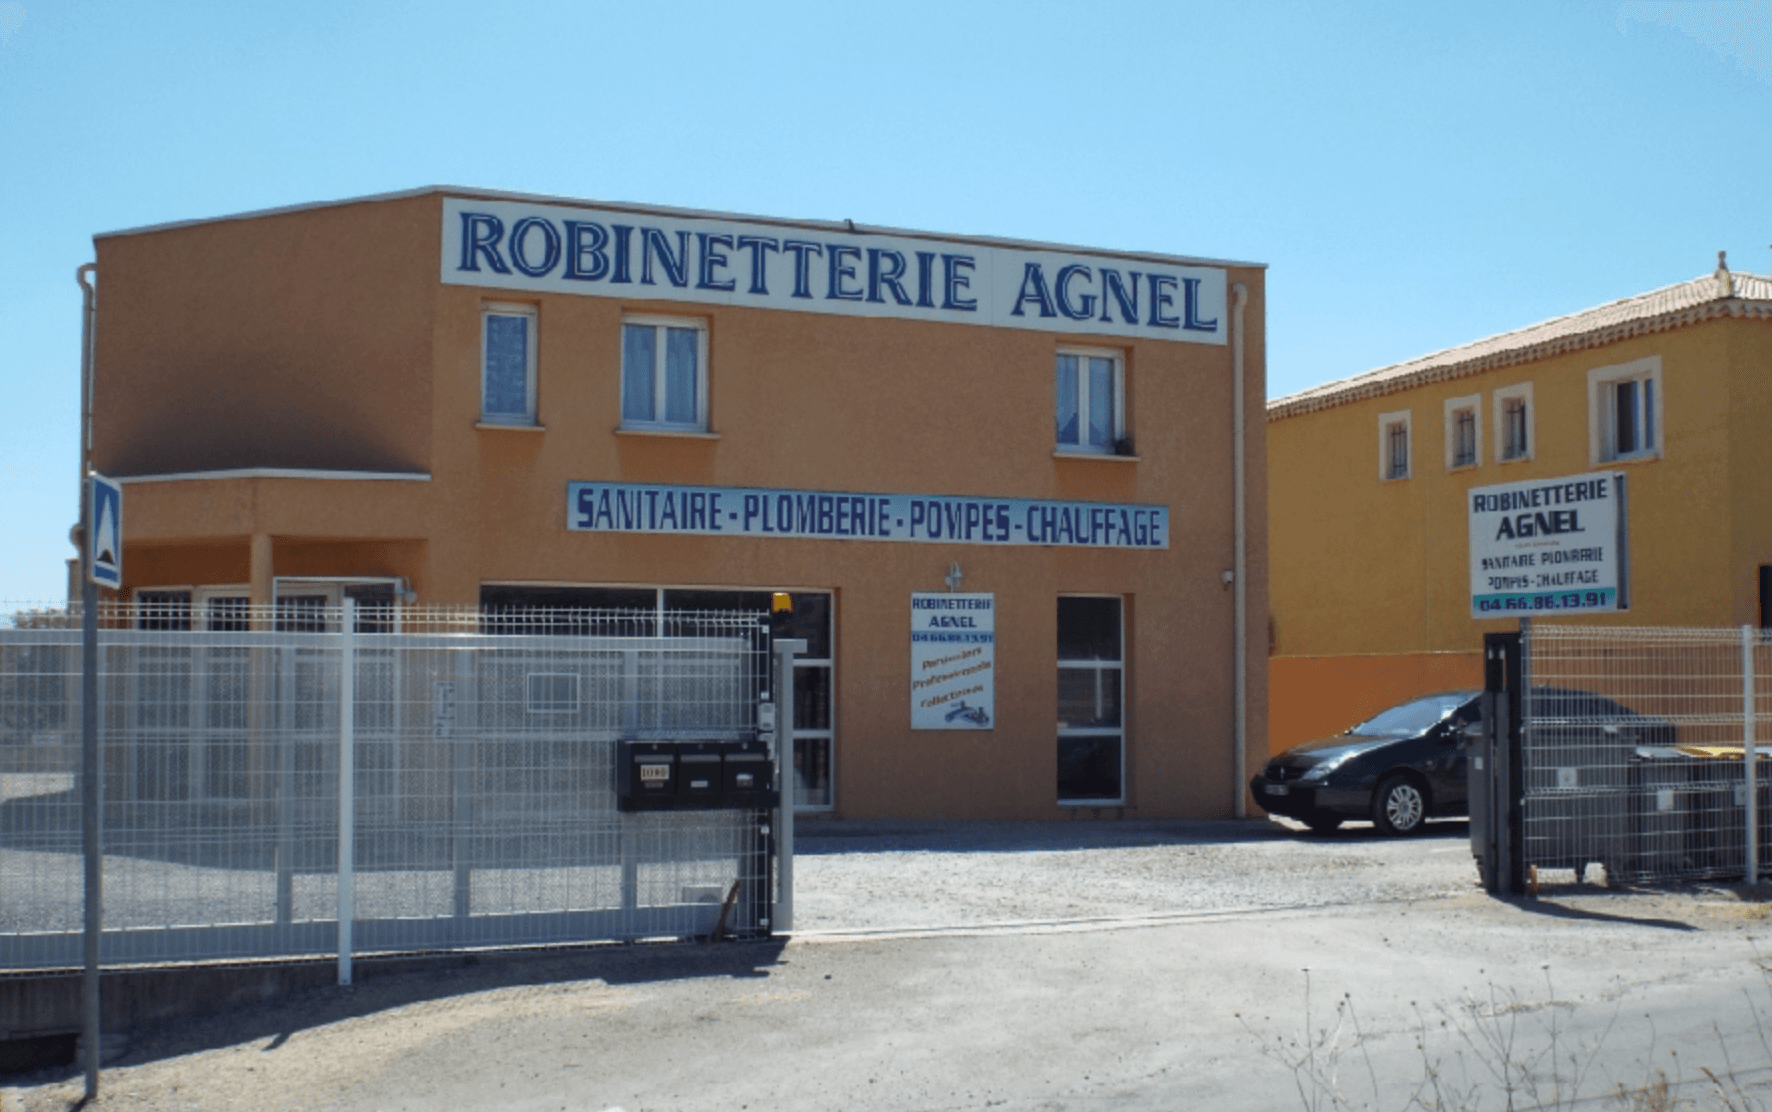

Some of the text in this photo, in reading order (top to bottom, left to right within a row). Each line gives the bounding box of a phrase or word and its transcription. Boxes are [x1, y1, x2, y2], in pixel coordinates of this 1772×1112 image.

[456, 211, 1218, 333] ROBINETTERIE AGNEL
[1473, 479, 1608, 513] ROBINETTERIE
[577, 488, 722, 531] SANITAIRE
[743, 494, 890, 537] PLOMBERIE
[910, 500, 1010, 542] POMPES
[1027, 506, 1161, 546] CHAUFFAGE
[1496, 509, 1586, 541] AGNEL
[912, 598, 992, 610] ROBINETTERIE
[929, 615, 977, 628] AGNEL
